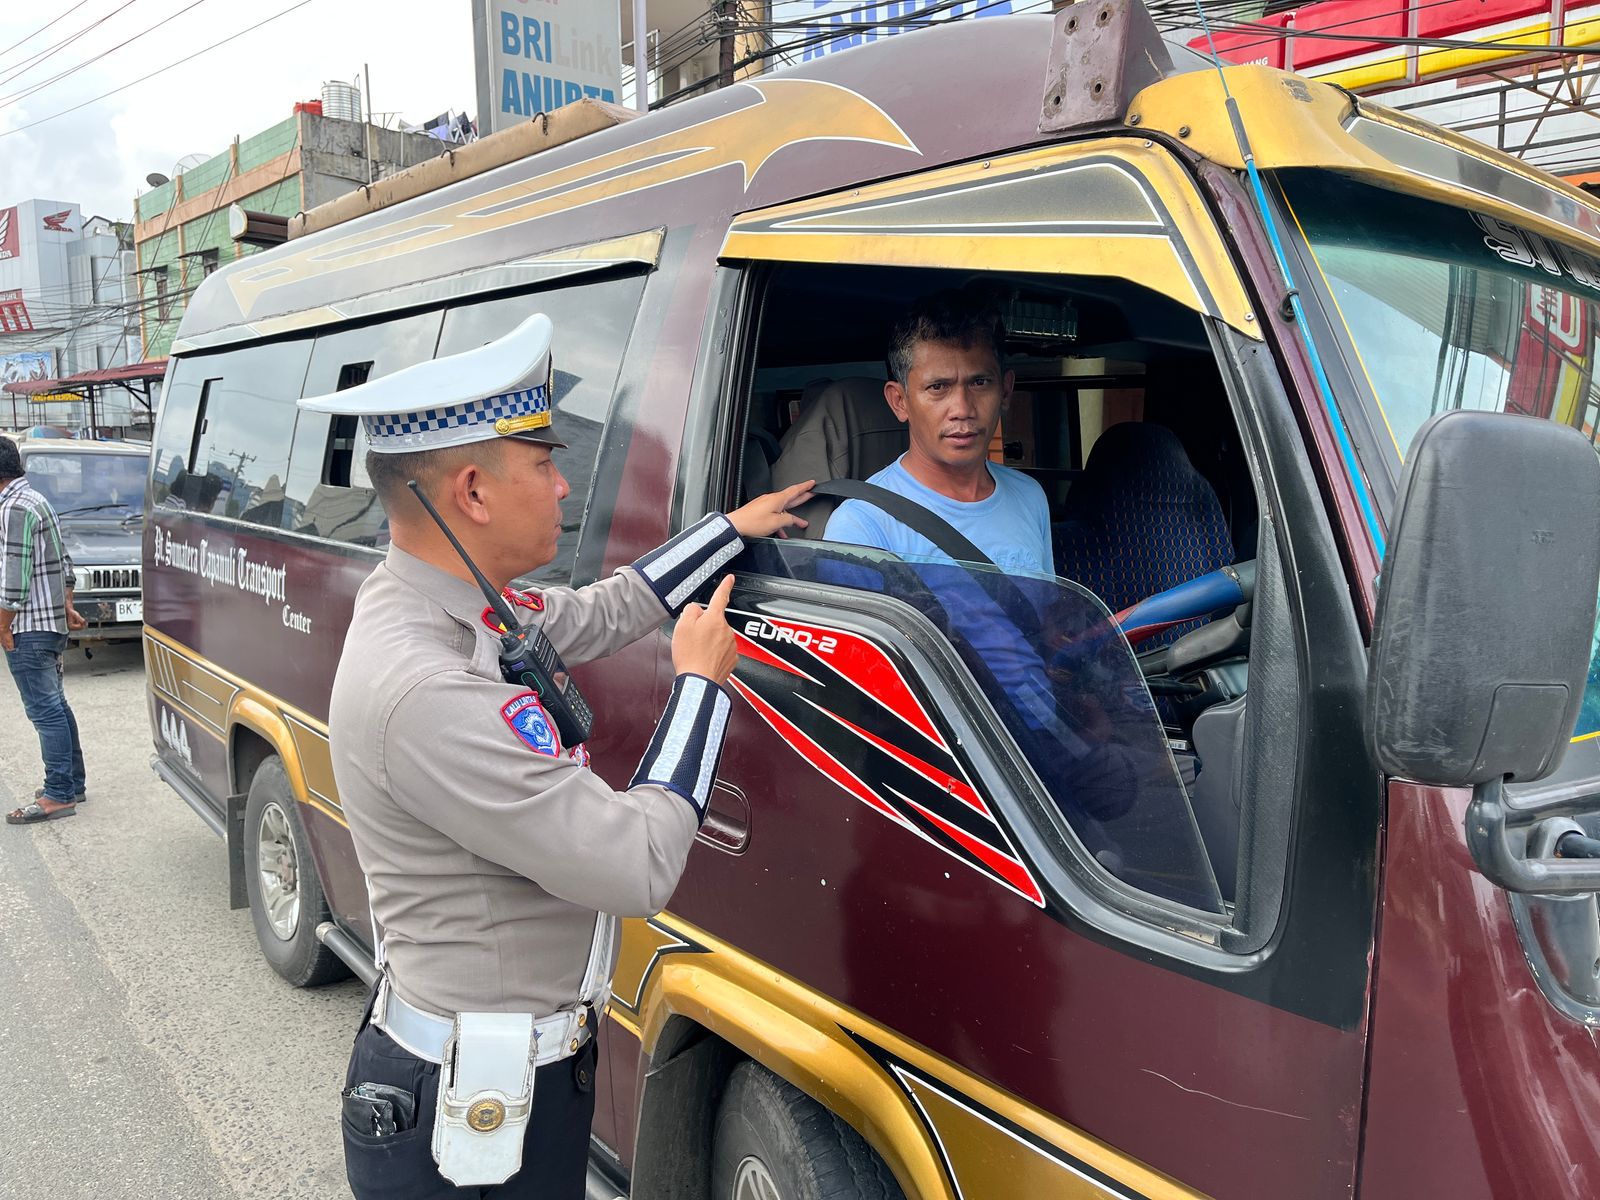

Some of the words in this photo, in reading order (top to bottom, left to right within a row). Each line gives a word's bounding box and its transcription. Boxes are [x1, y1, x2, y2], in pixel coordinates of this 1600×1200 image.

[165, 530, 198, 574] Sumatera
[238, 547, 287, 606] Transport
[119, 603, 132, 615] BK
[282, 604, 312, 634] Center
[744, 620, 838, 654] EURO-2
